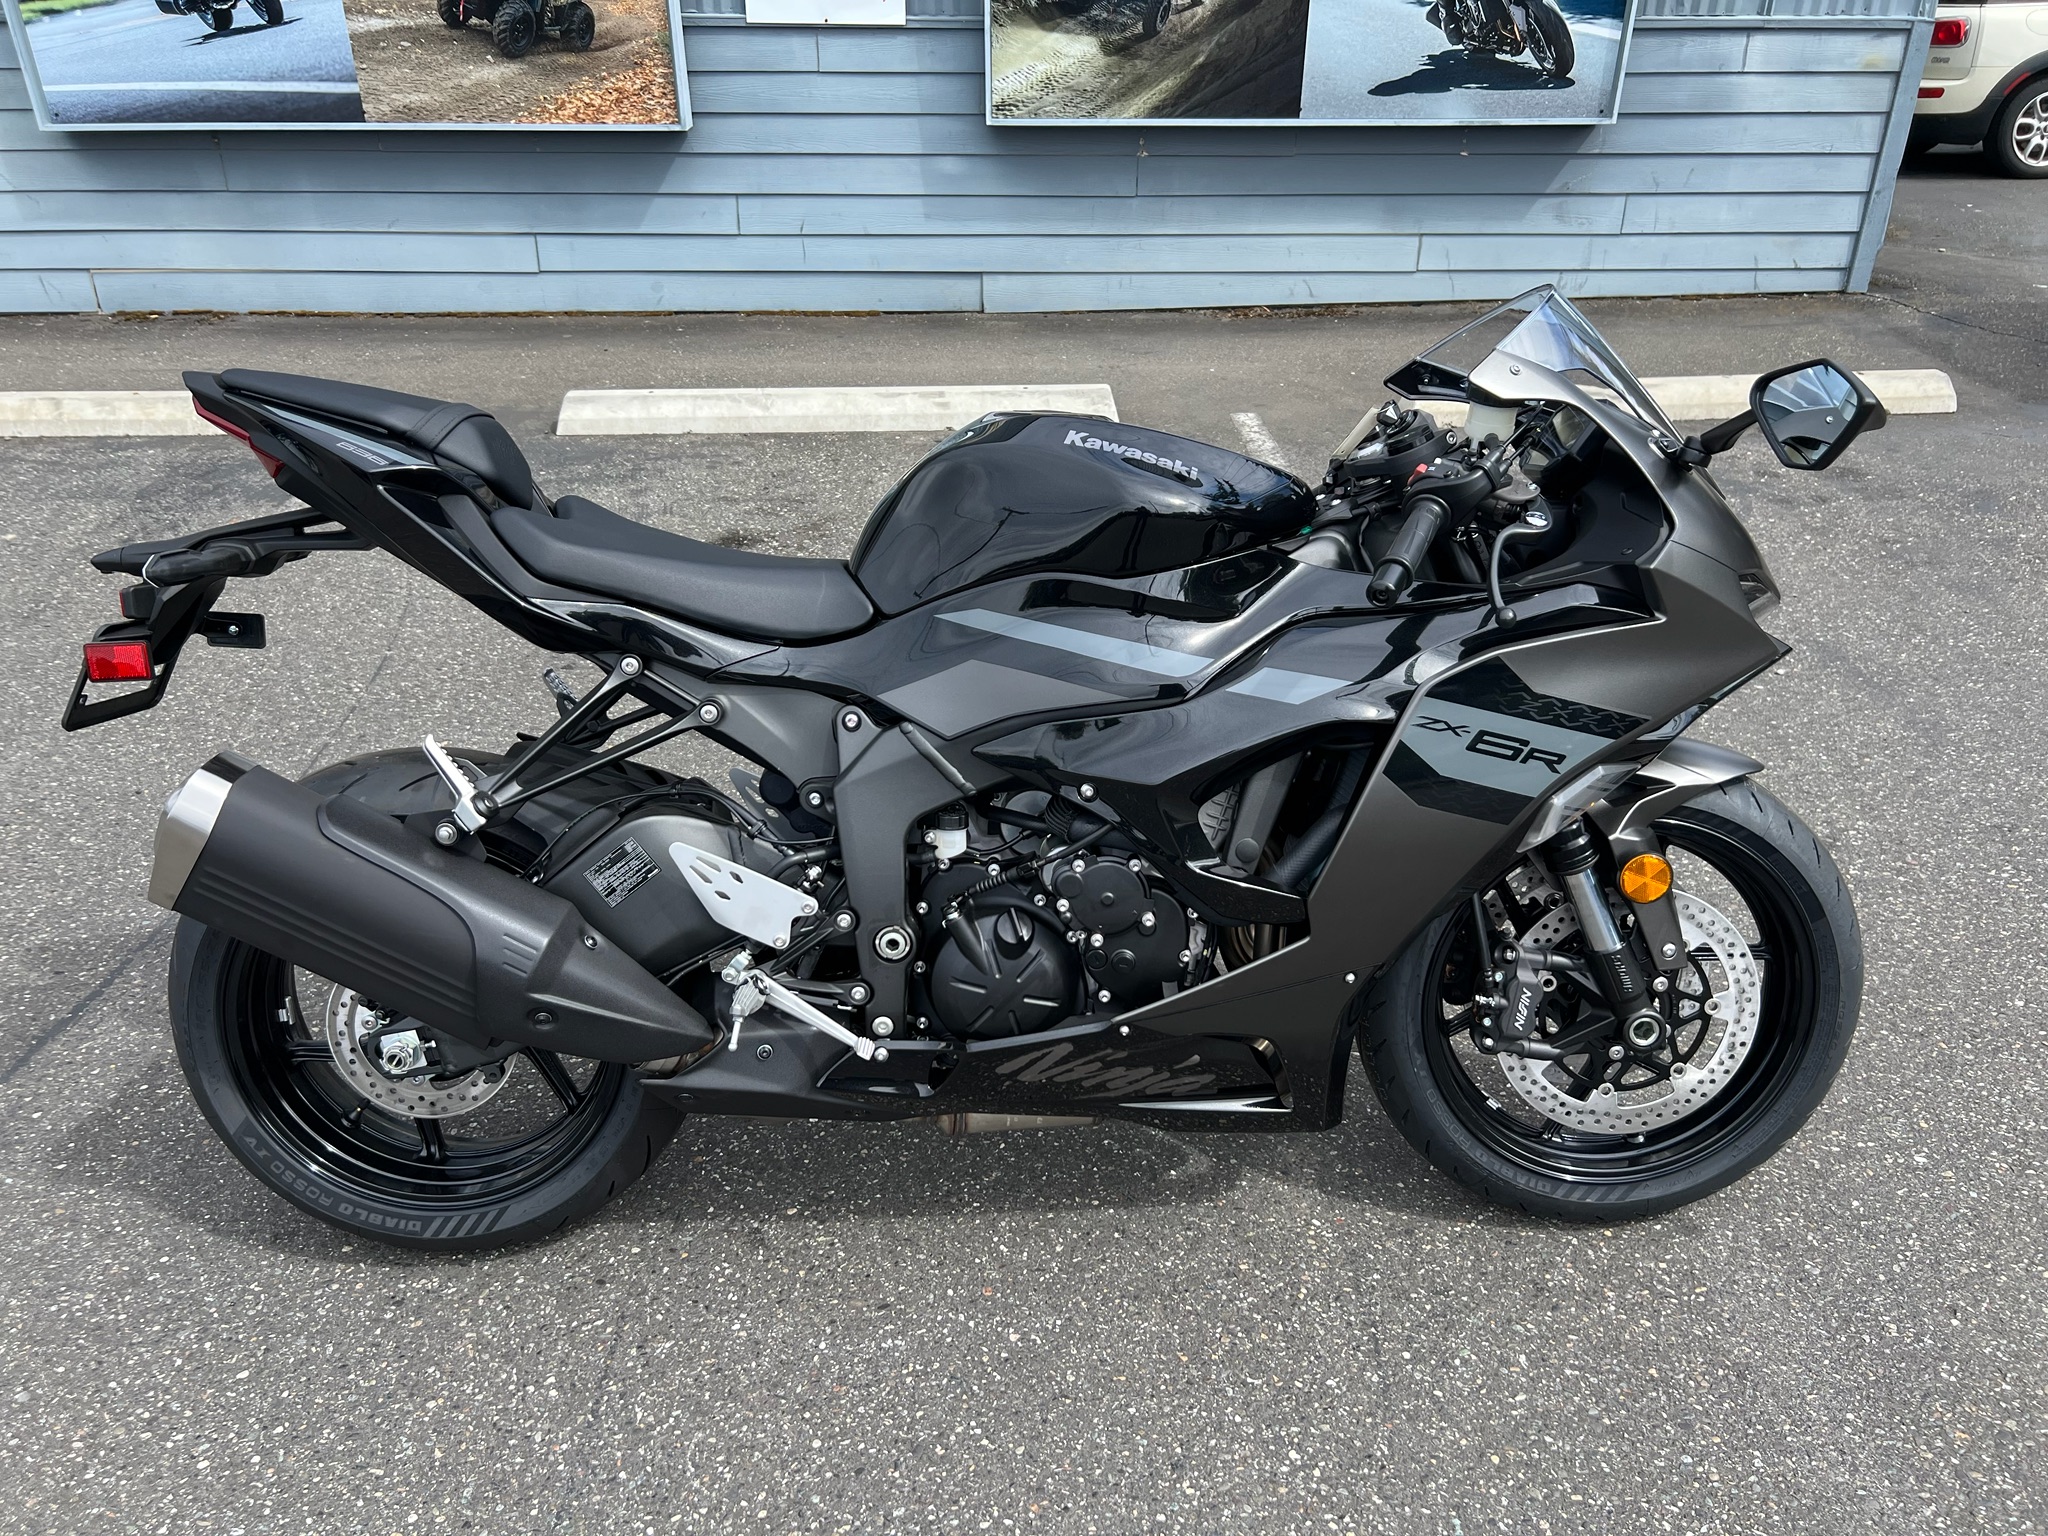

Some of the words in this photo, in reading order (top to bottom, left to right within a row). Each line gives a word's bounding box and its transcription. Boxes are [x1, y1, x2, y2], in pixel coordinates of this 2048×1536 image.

[1063, 430, 1199, 480] Kawasaki
[995, 1042, 1218, 1099] Ninja
[1426, 1088, 1471, 1150] ROSSO
[244, 1136, 272, 1160] IV
[1474, 1150, 1550, 1192] DIABLO
[270, 1160, 334, 1207] ROSSO
[338, 1203, 422, 1234] DIABLO
